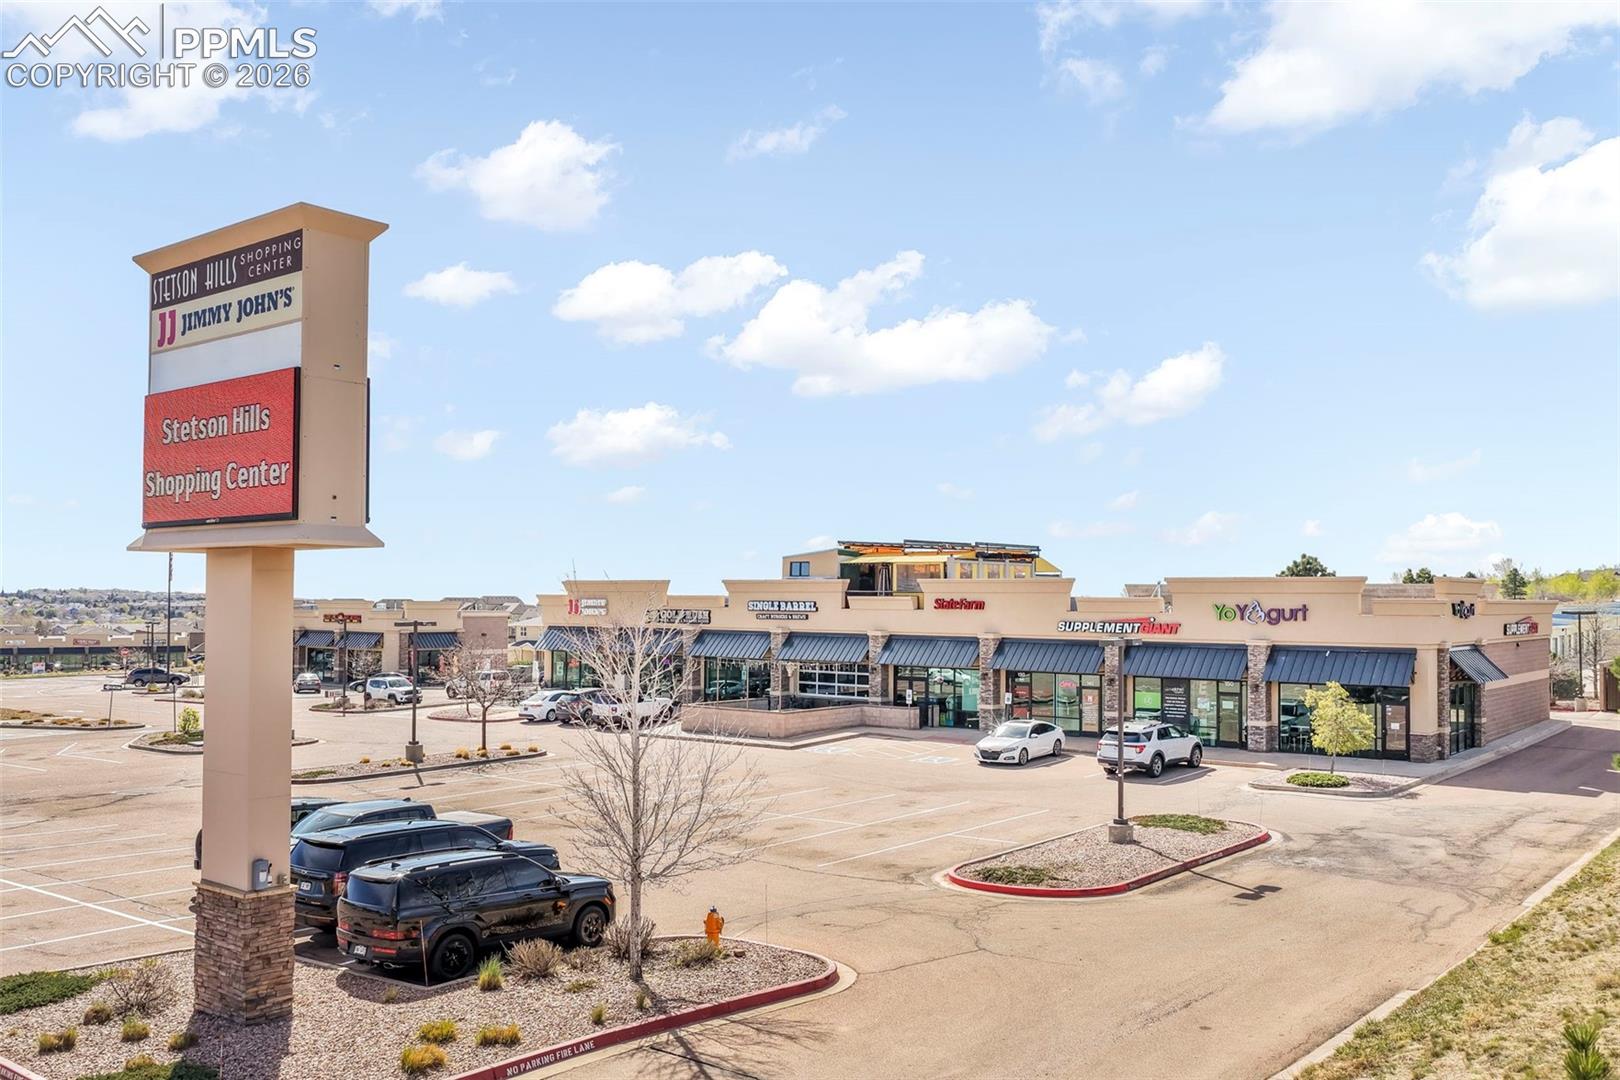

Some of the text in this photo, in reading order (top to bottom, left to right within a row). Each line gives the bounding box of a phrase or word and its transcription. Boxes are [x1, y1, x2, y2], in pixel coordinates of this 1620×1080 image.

[240, 236, 302, 265] SHOPPING
[248, 256, 292, 277] CENTER
[153, 255, 238, 305] STETSON HILLS
[181, 287, 292, 336] JIMMY JOHN'S
[162, 403, 271, 445] Stetson Hills
[145, 459, 291, 504] Shopping Center
[748, 601, 817, 612] SINGLE BARREL
[506, 1040, 596, 1077] NO PARKING FIRE LANE
